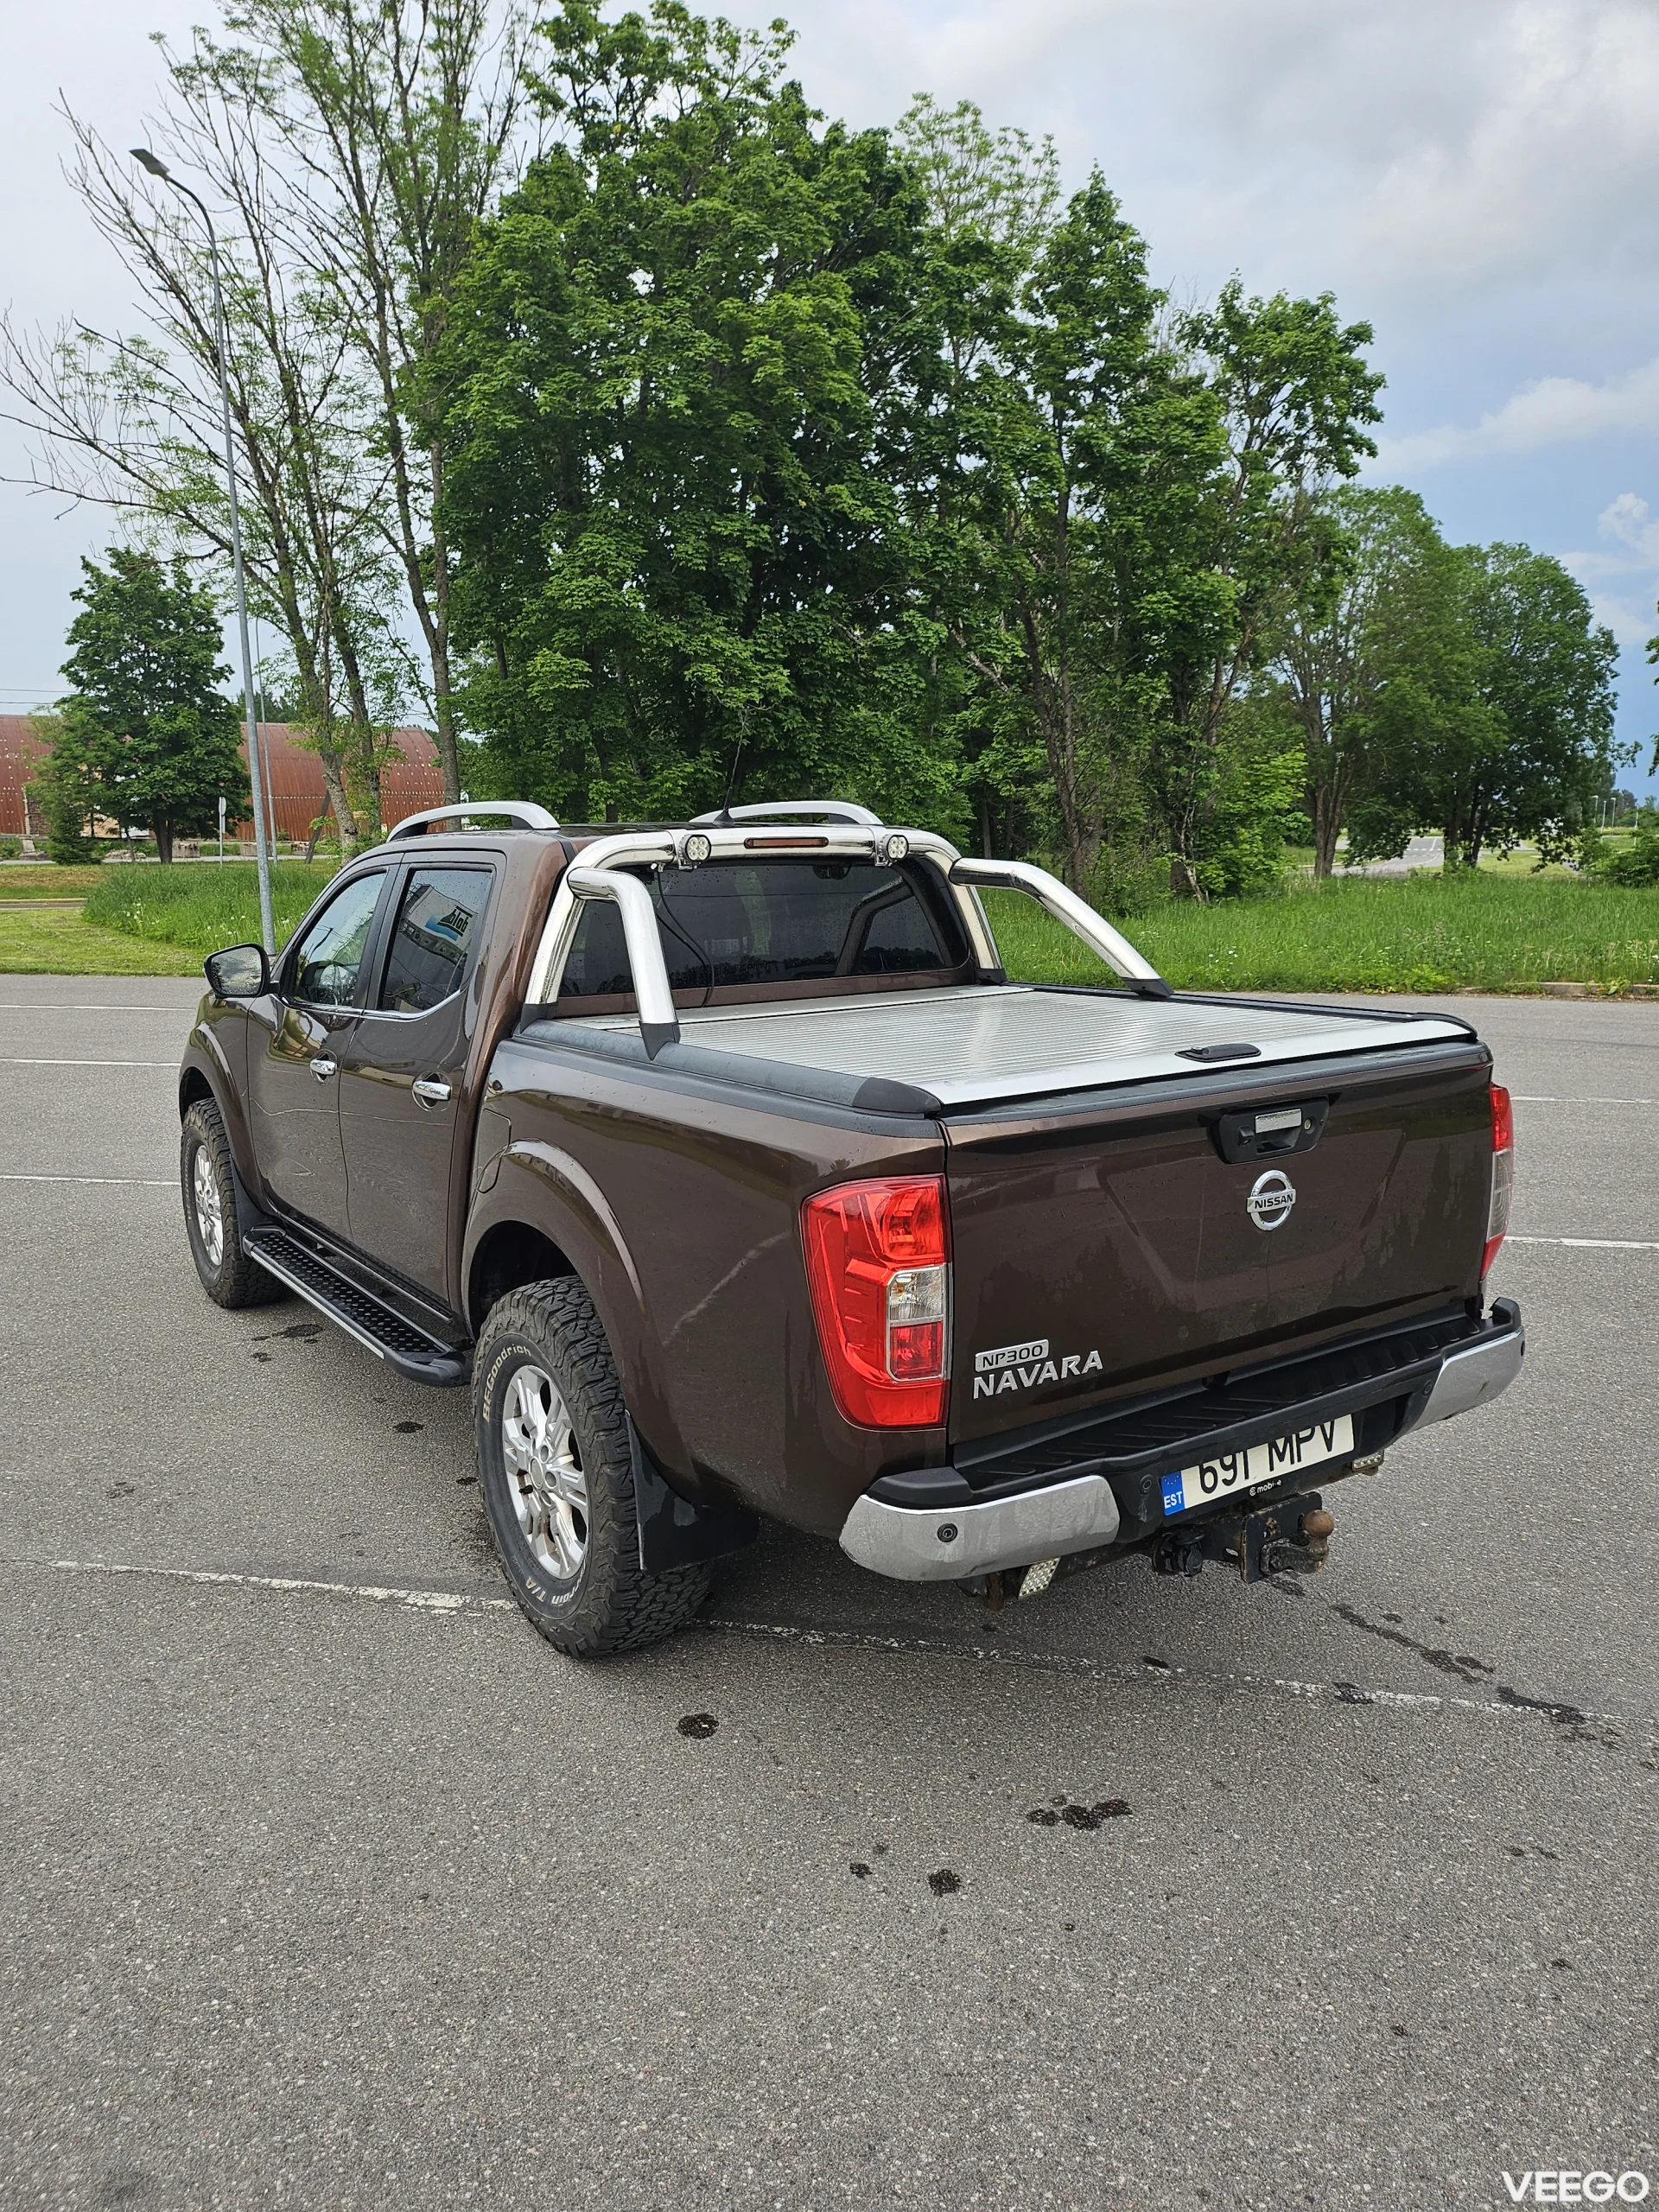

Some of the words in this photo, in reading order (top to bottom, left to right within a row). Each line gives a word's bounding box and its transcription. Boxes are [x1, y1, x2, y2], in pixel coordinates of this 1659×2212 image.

[1254, 1193, 1294, 1210] NISSAN
[982, 1344, 1043, 1369] NP300
[483, 1344, 532, 1422] BFGoodrich
[973, 1350, 1103, 1400] NAVARA
[1198, 1449, 1249, 1494] 691
[1267, 1419, 1336, 1472] MPV
[1256, 1479, 1281, 1494] mobie
[1164, 1491, 1183, 1509] EST
[525, 1576, 547, 1603] T/A
